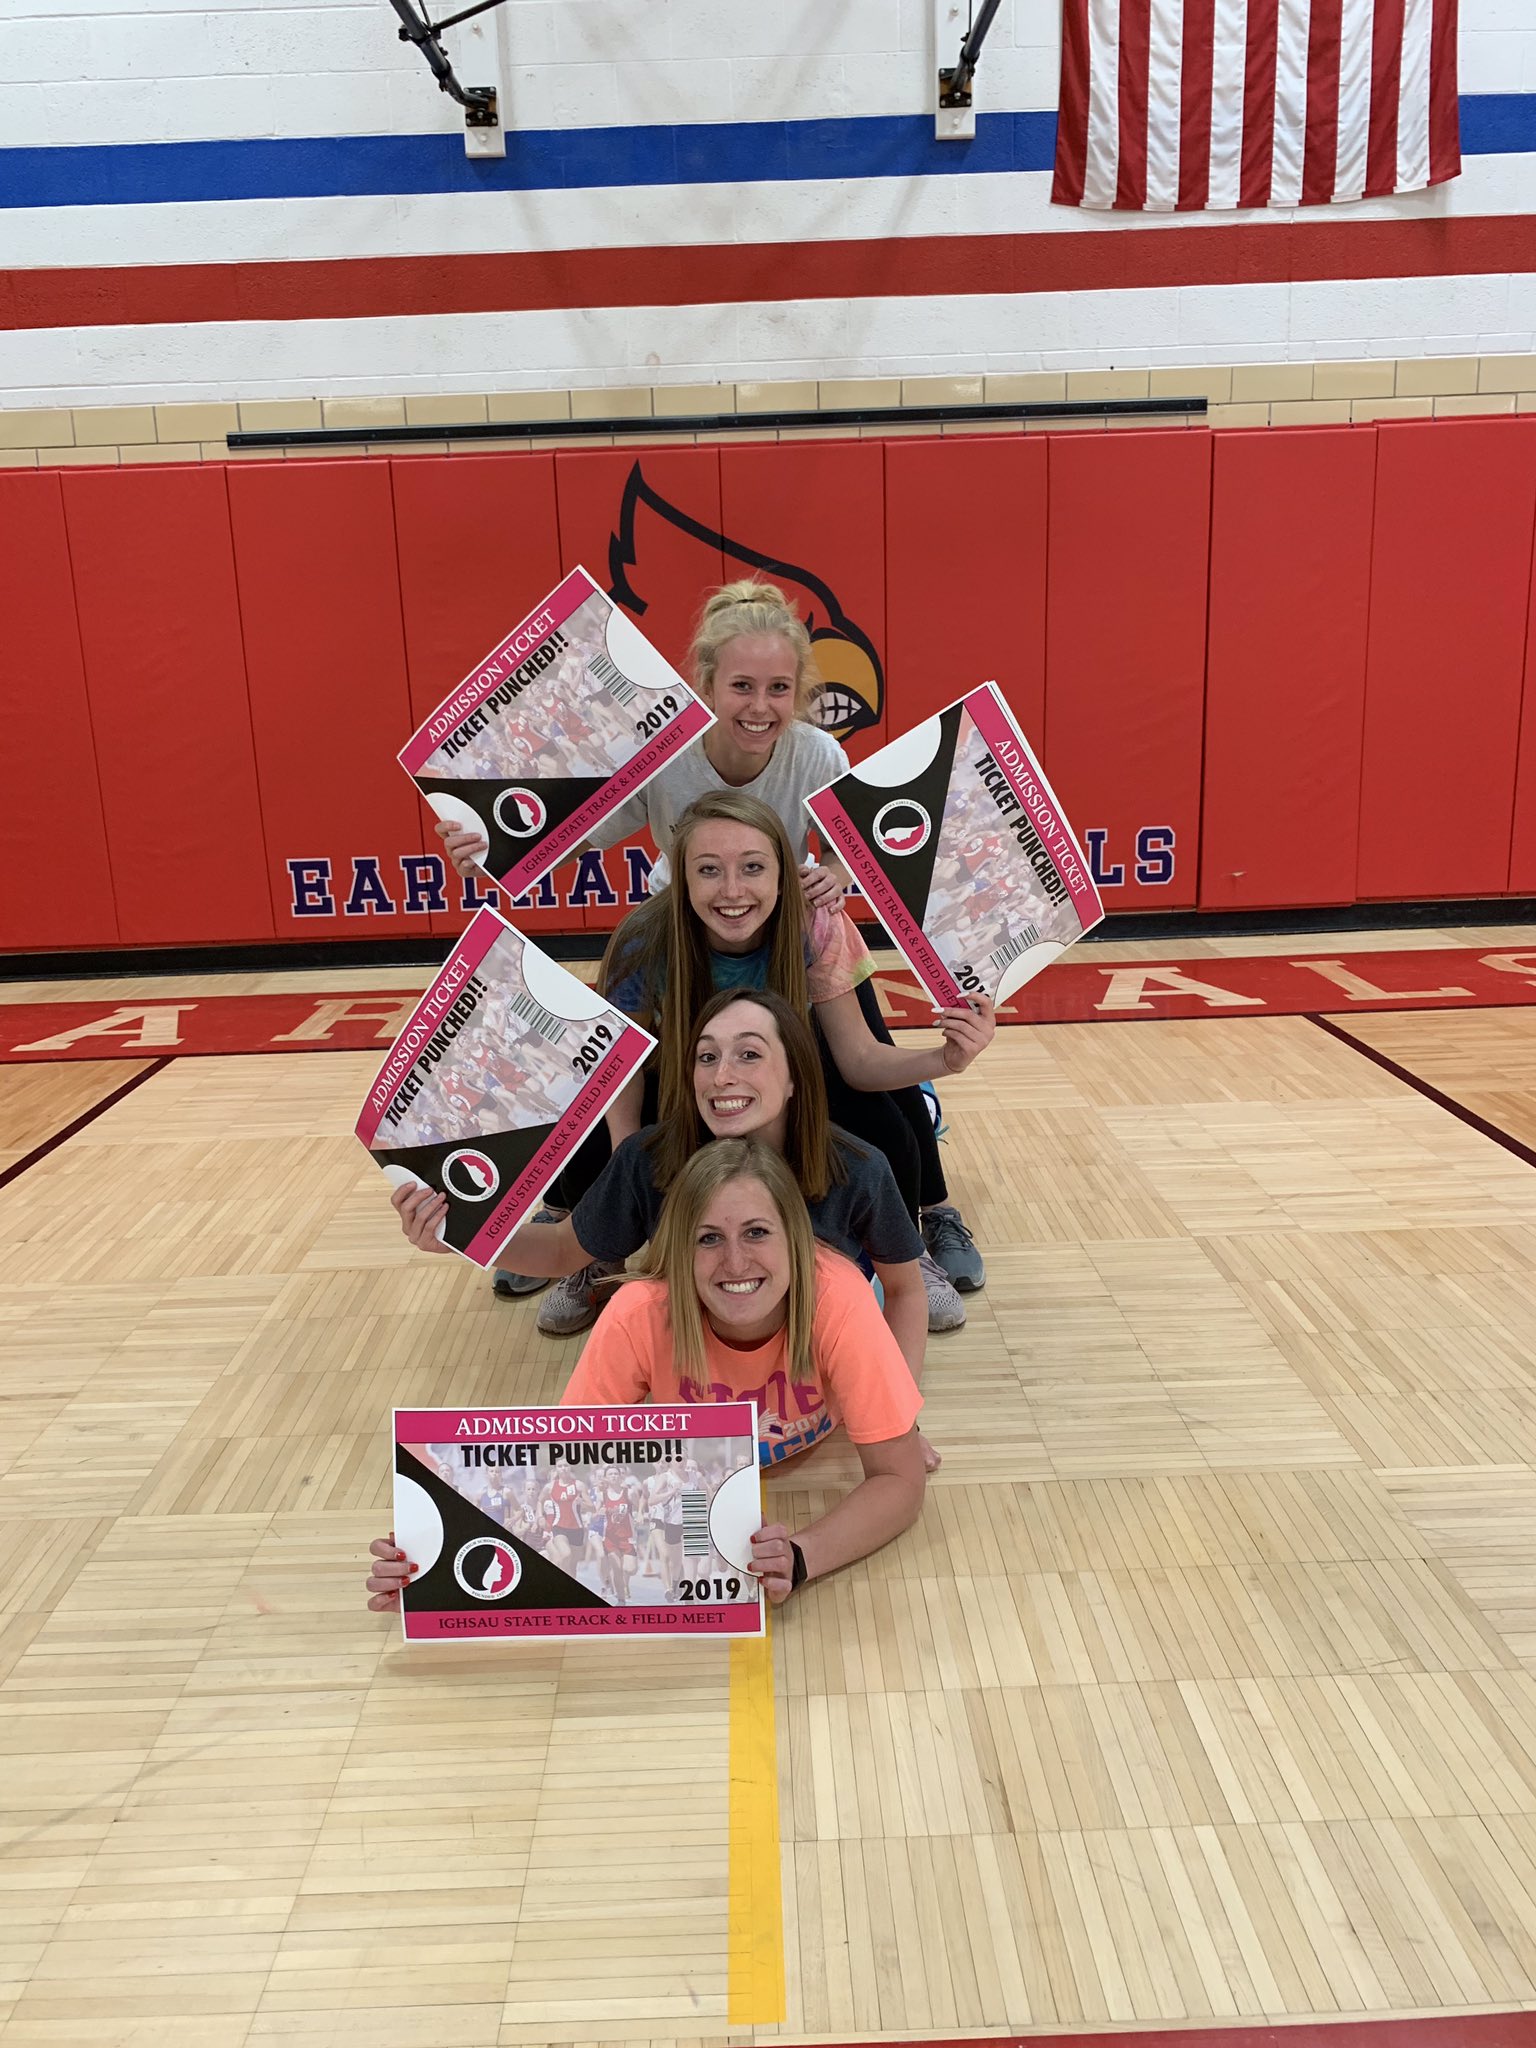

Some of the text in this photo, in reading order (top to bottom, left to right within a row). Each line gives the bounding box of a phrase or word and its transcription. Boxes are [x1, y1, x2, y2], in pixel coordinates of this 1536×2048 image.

[427, 608, 556, 744] ADMISSION TICKET
[440, 630, 570, 760] TICKET PUNCHED!!
[636, 694, 680, 740] 2019
[522, 839, 560, 875] IGHSAU
[557, 812, 589, 842] STATE
[585, 785, 618, 816] TRACK
[618, 776, 630, 788] &
[627, 750, 658, 778] FIELD
[654, 724, 685, 753] MEET
[974, 753, 1070, 908] TICKET PUNCHED!!
[994, 739, 1088, 896] ADMISSION TICKET
[830, 814, 961, 1008] IGHSAU STATE TRACK & FIELD MEET
[372, 952, 471, 1115] ADMISSION TICKET
[384, 976, 488, 1128] TICKET PUNCHED!!
[572, 1024, 614, 1077] 2019
[486, 1054, 625, 1240] IGHSAU STATE TRACK & FIELD MEET
[455, 1413, 692, 1436] ADMISSION TICKET
[461, 1439, 684, 1468] TICKET PUNCHED!!
[439, 1612, 726, 1629] IGHSAU STATE TRACK & FIELD MEET
[679, 1577, 741, 1601] 2019
